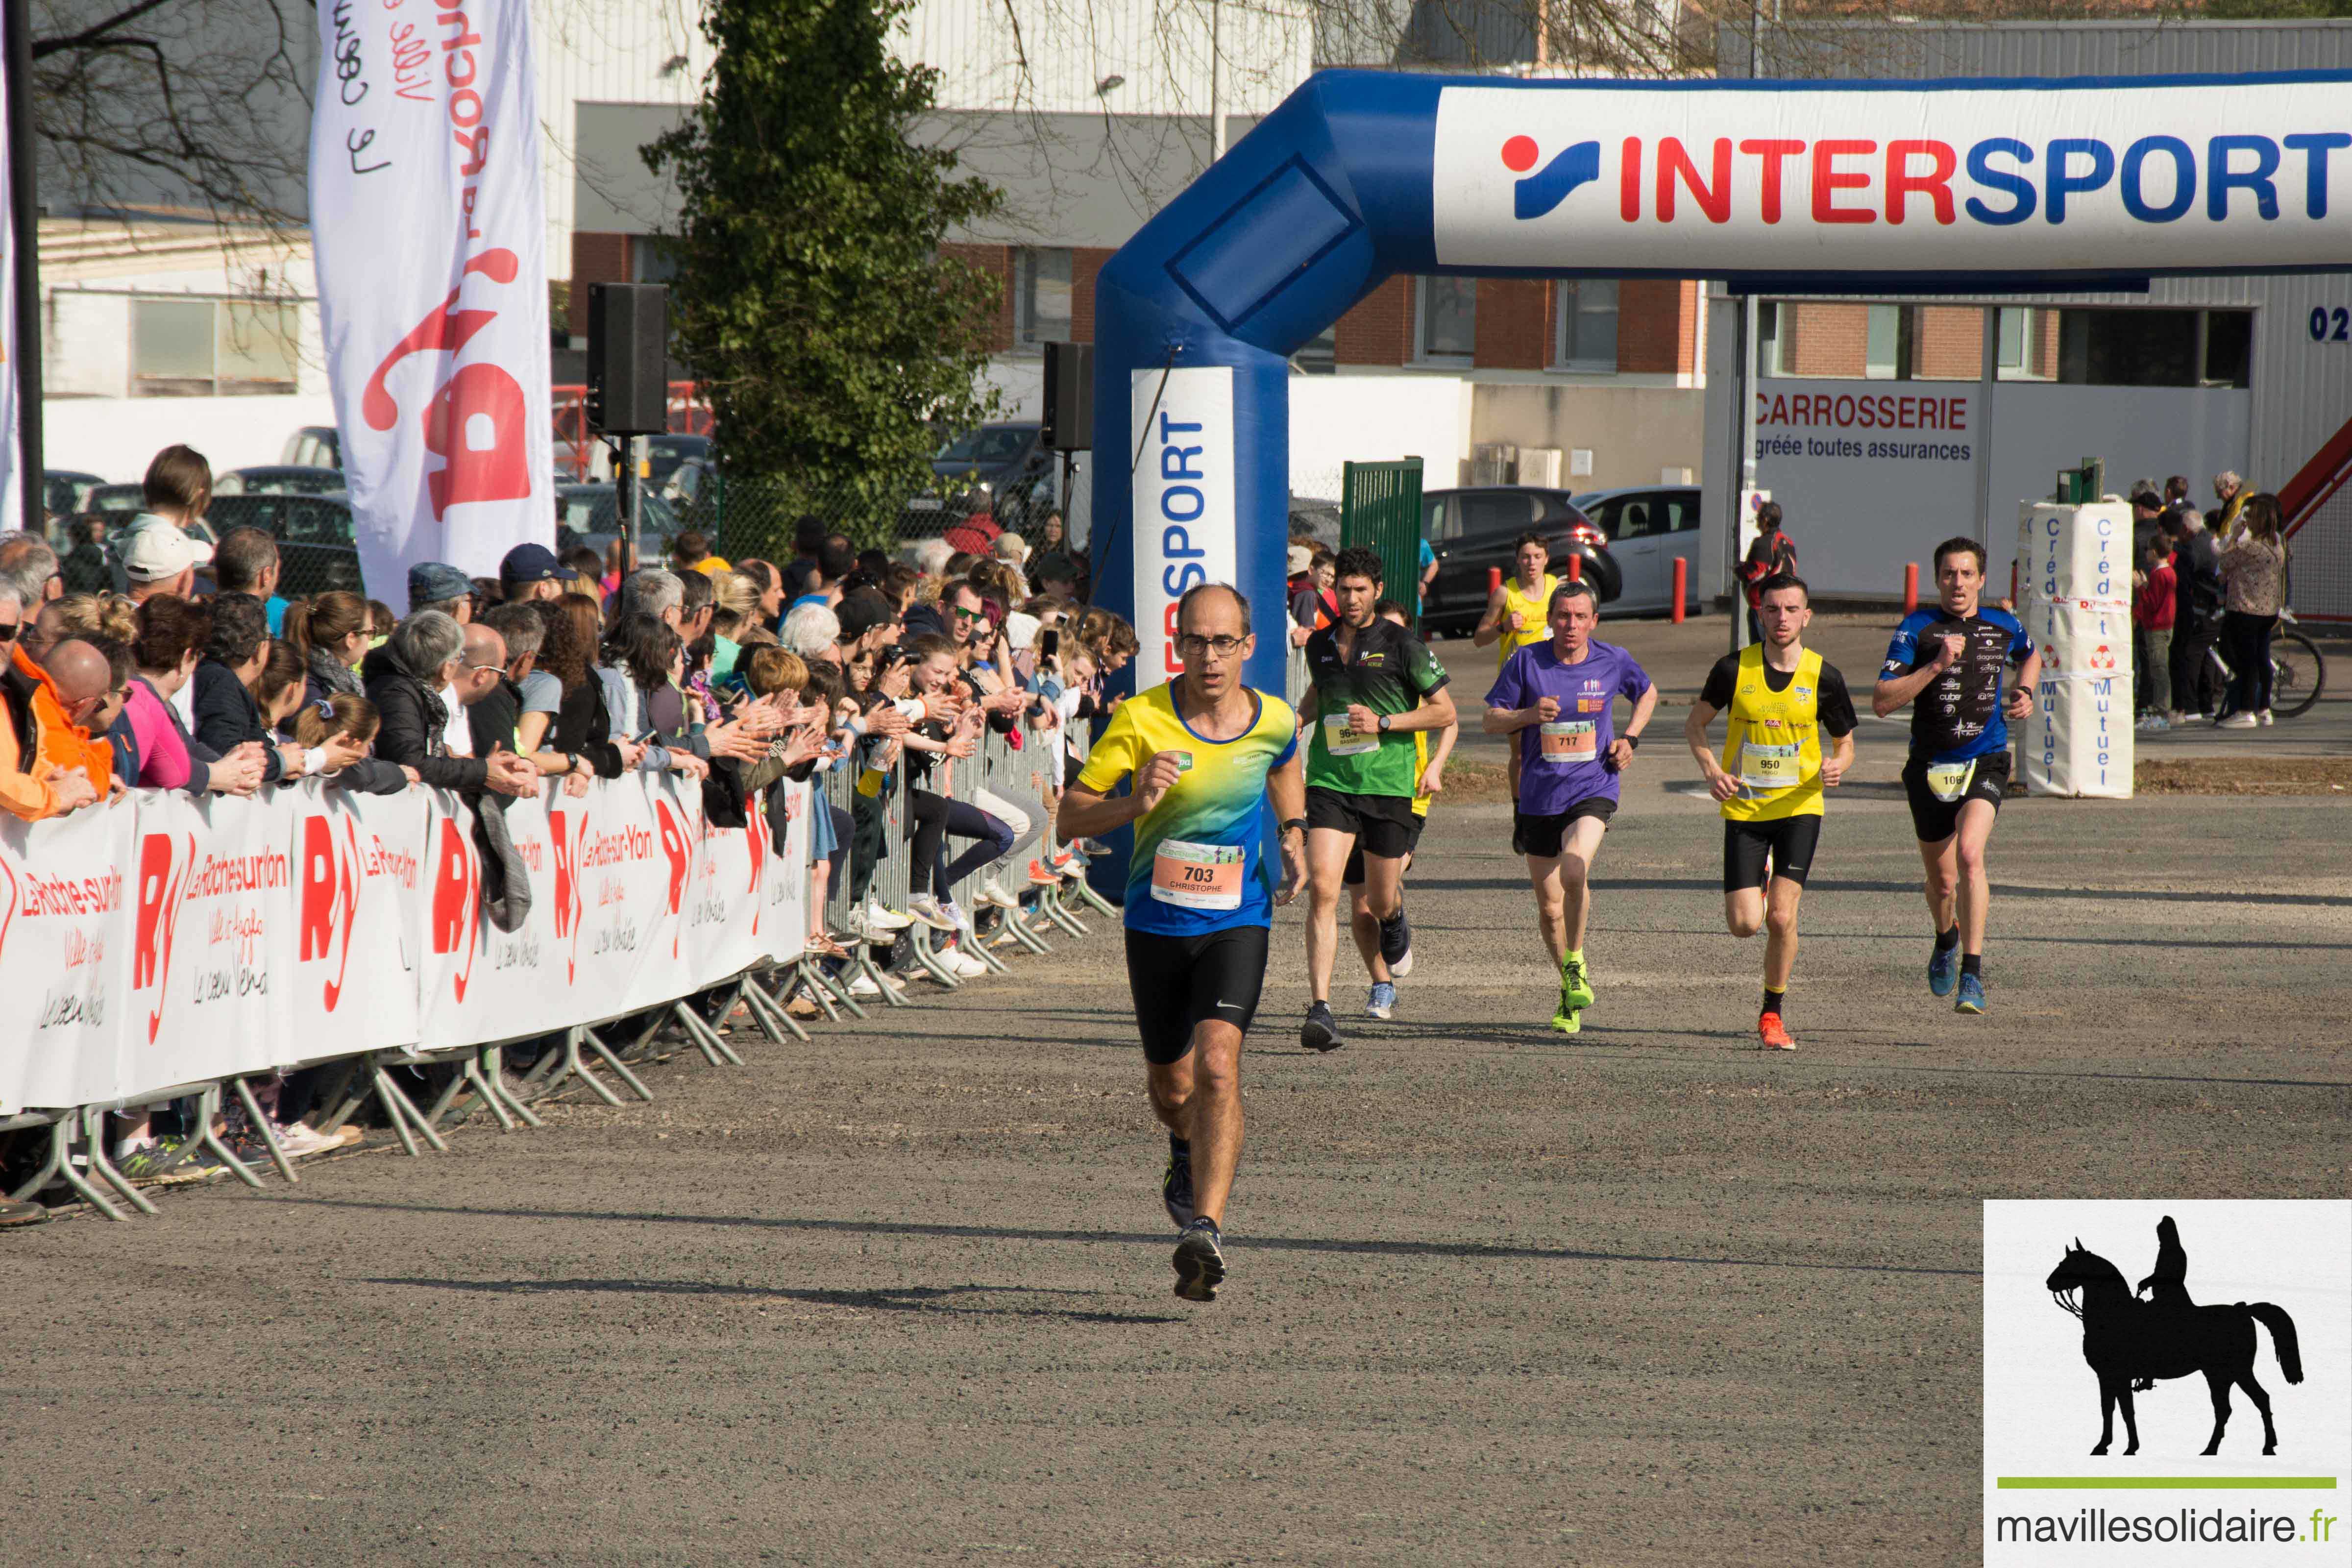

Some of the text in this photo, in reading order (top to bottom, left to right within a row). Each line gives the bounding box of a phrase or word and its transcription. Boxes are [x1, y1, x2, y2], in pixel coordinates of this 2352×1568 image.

[1621, 132, 2351, 225] INTERSPORT
[2309, 306, 2350, 342] 02
[1756, 434, 1971, 461] gréée toutes assurances
[2094, 518, 2112, 786] Crédt Mutuel
[1559, 736, 1577, 746] 717
[2040, 681, 2058, 784] Mutuel
[1760, 760, 1780, 769] 950
[1170, 881, 1223, 892] CHRISTOPHE
[1183, 866, 1214, 882] 703
